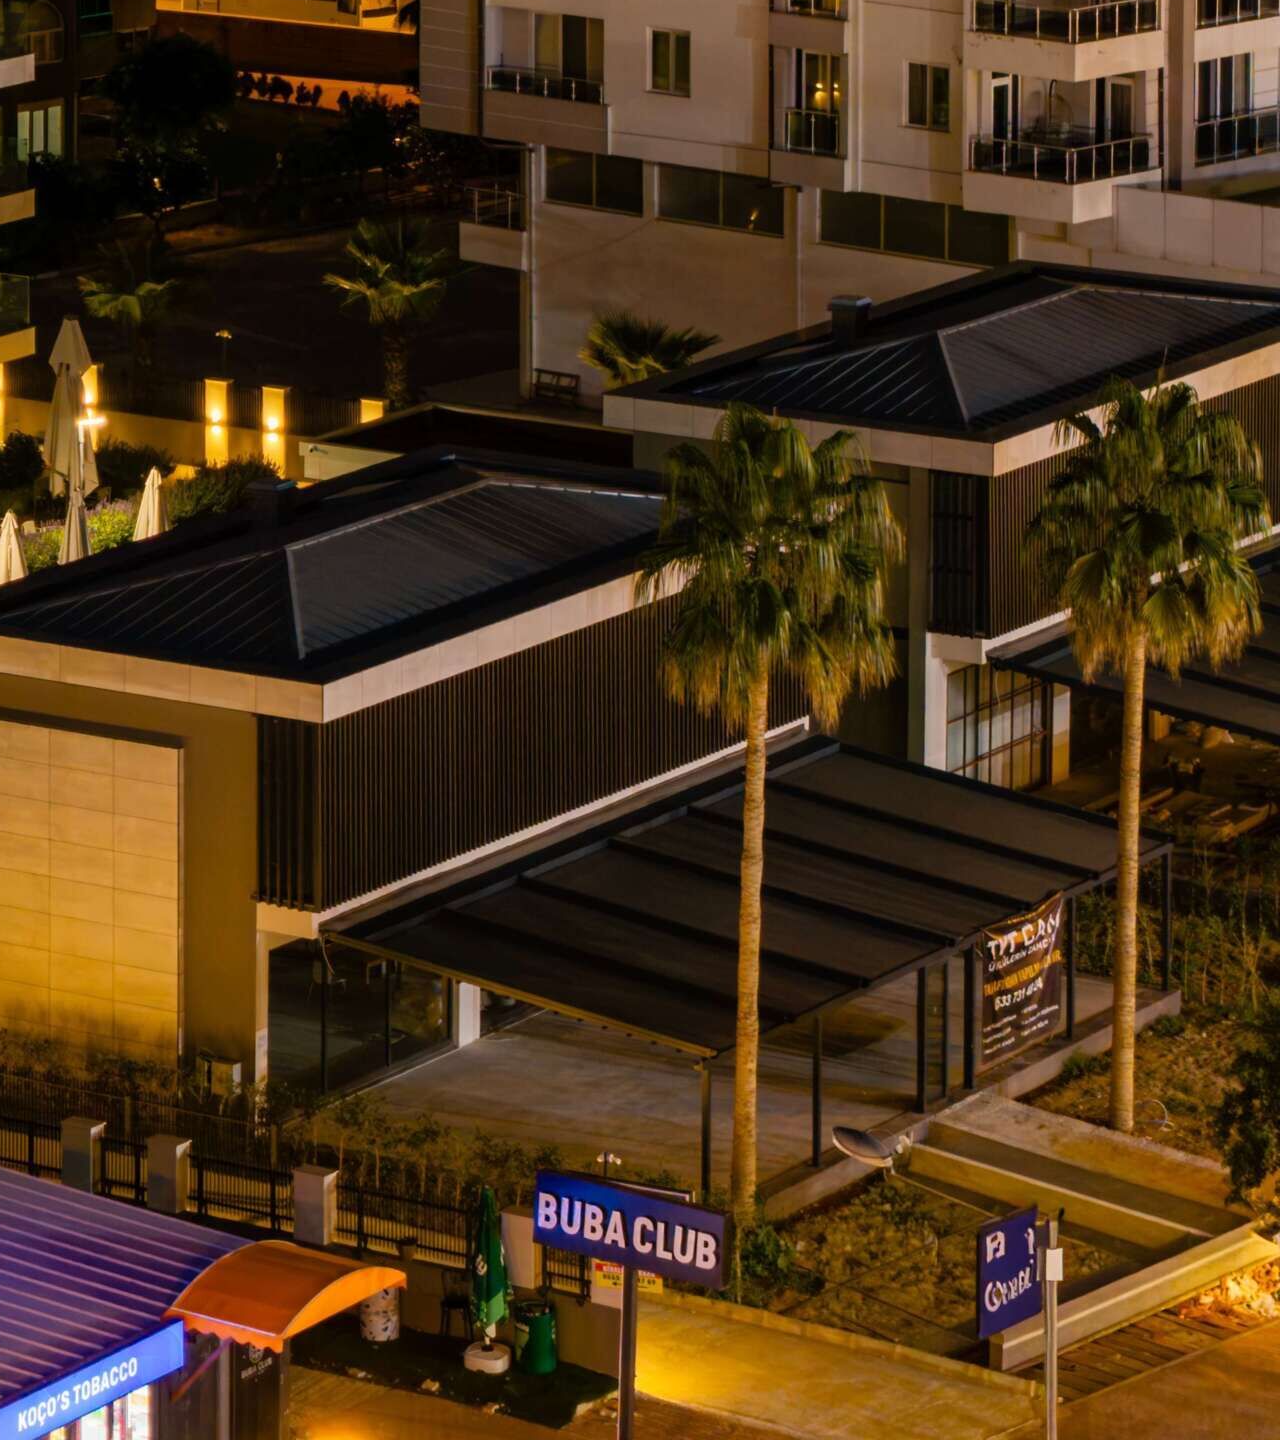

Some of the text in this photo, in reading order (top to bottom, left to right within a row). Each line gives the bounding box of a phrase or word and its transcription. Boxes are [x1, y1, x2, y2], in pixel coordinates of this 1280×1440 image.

[537, 1191, 717, 1270] BUBA CLUB
[72, 1356, 138, 1405] TOBACCO
